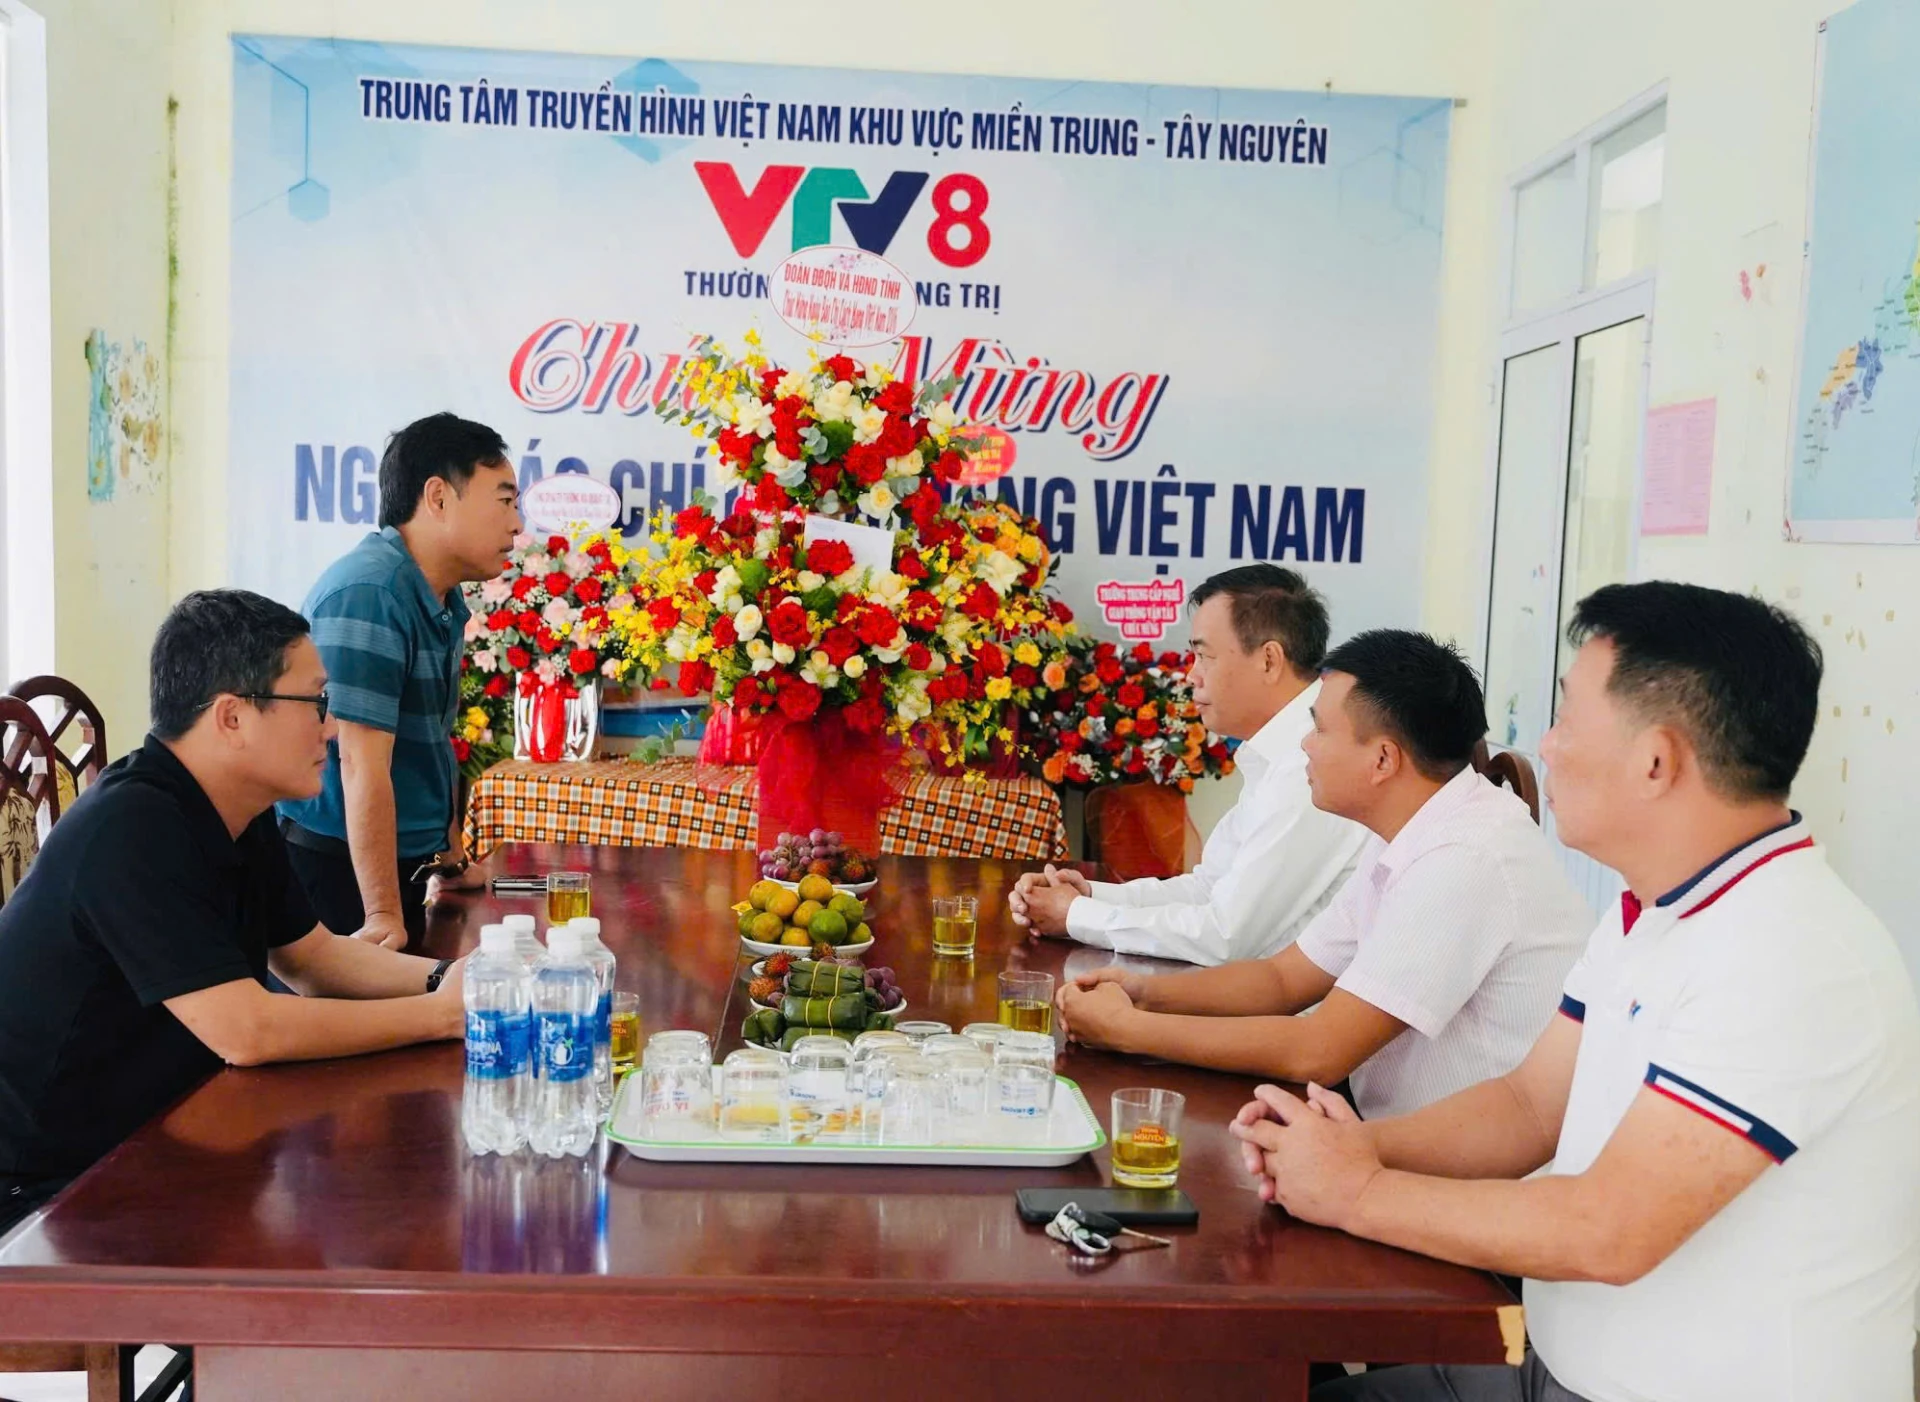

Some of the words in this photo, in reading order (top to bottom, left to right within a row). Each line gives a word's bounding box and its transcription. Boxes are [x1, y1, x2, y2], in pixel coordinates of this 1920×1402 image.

[360, 79, 451, 122] TRUNG
[459, 78, 518, 128] TÂM
[526, 80, 631, 132] TRUYỀN
[639, 88, 703, 137] HÌNH
[713, 93, 770, 148] VIỆT
[777, 104, 841, 144] NAM
[850, 107, 903, 146] KHU
[911, 107, 963, 157] VỰC
[971, 102, 1041, 153] MIỀN
[1049, 116, 1138, 157] TRUNG
[1163, 114, 1211, 160] TÂY
[1218, 118, 1328, 165] NGUYÊN
[693, 161, 992, 268] VTV8
[684, 266, 769, 299] THƯỜN
[960, 283, 1001, 315] TRỊ
[784, 262, 811, 285] ĐOÀN
[1094, 464, 1216, 575] VIỆT
[1230, 484, 1366, 563] NAM
